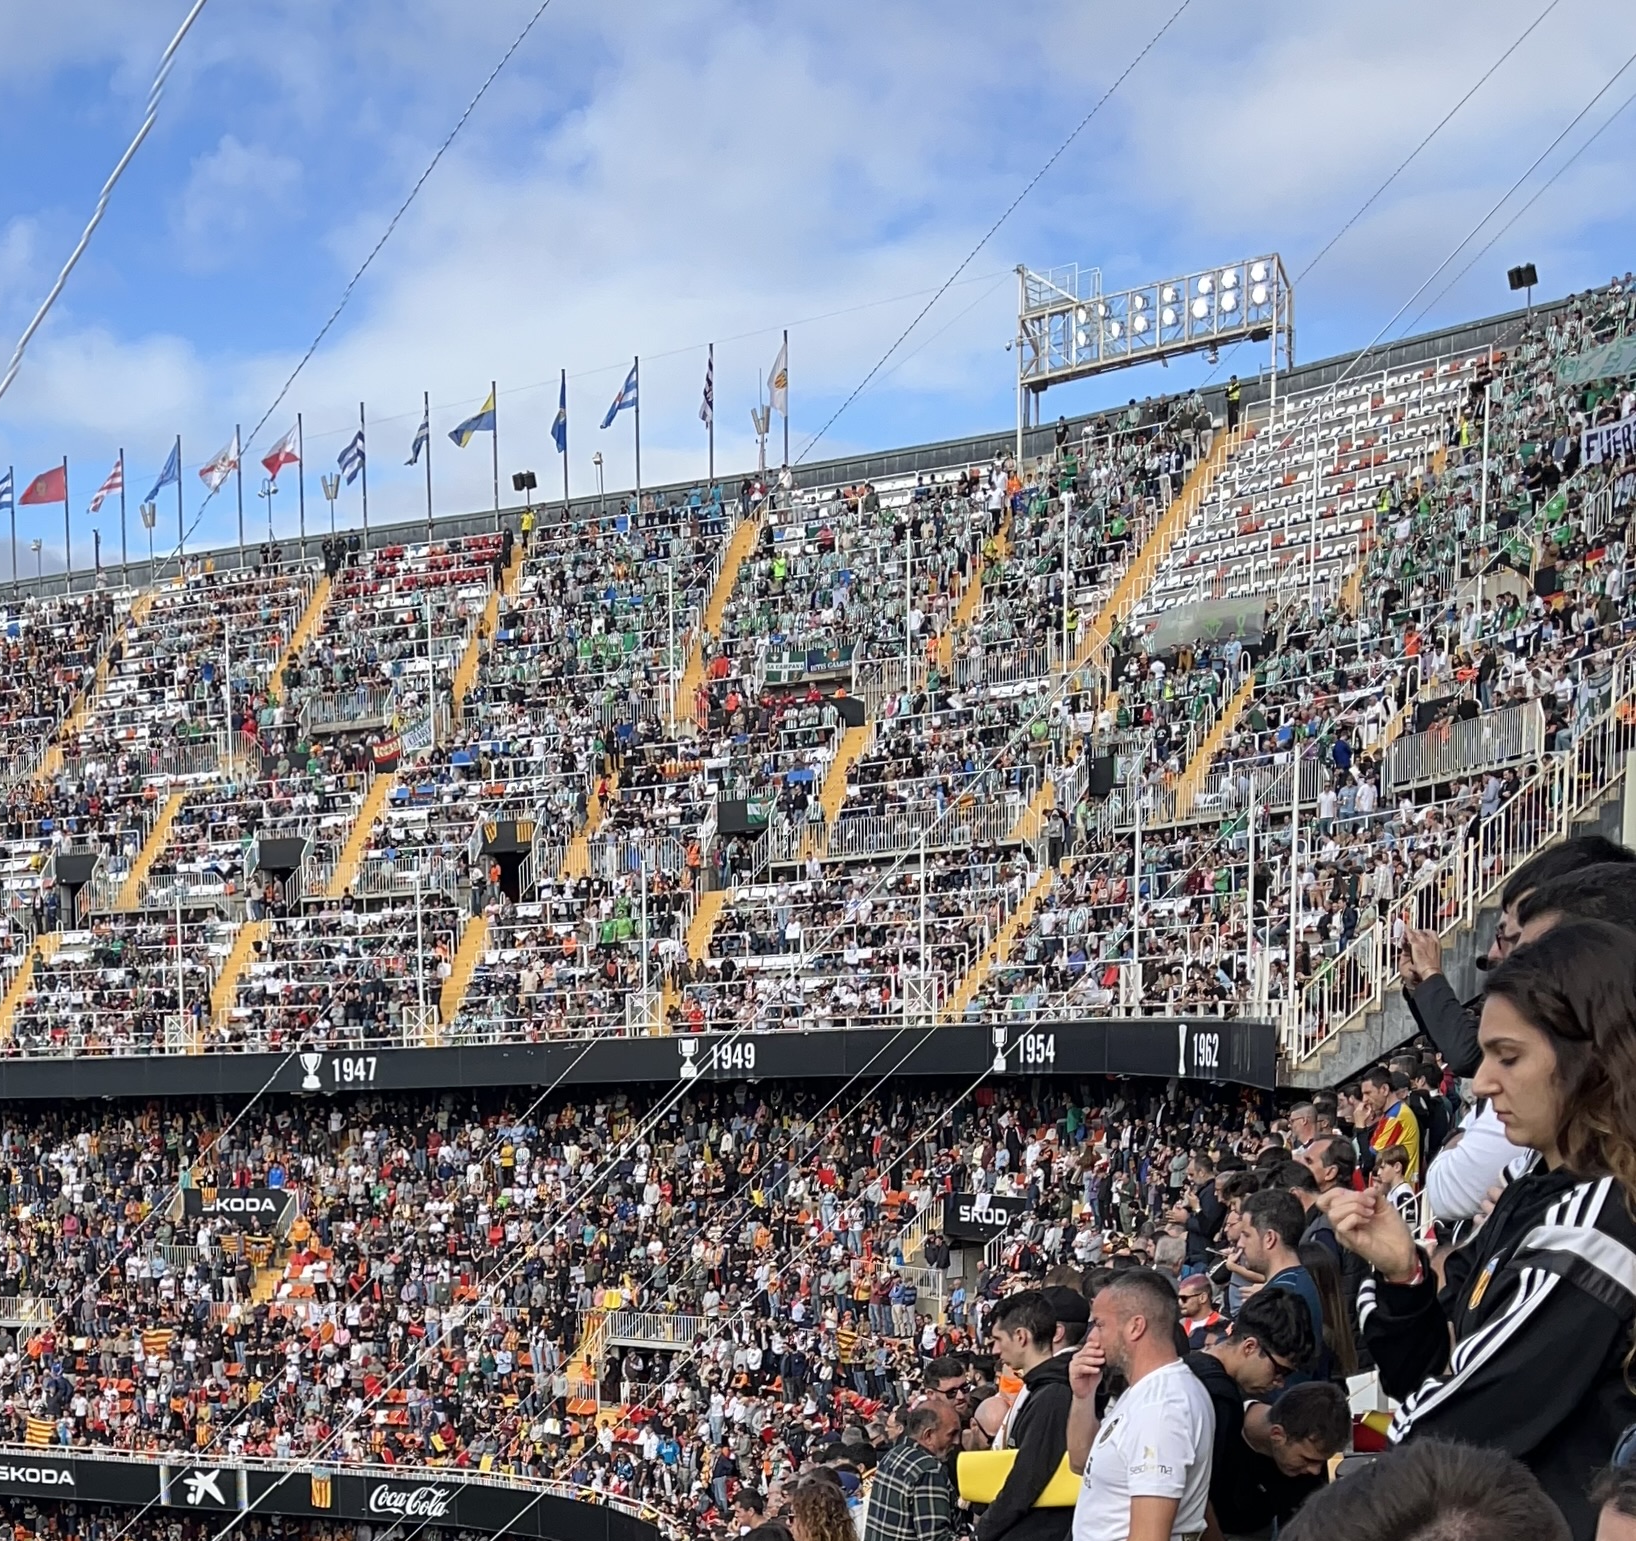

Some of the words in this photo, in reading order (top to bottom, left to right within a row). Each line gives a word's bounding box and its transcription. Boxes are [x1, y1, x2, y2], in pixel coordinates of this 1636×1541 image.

[712, 1042, 755, 1070] 1949
[1018, 1033, 1056, 1064] 1954
[1192, 1032, 1219, 1067] 1962
[331, 1056, 377, 1083] 1947
[959, 1205, 1007, 1226] SKOD
